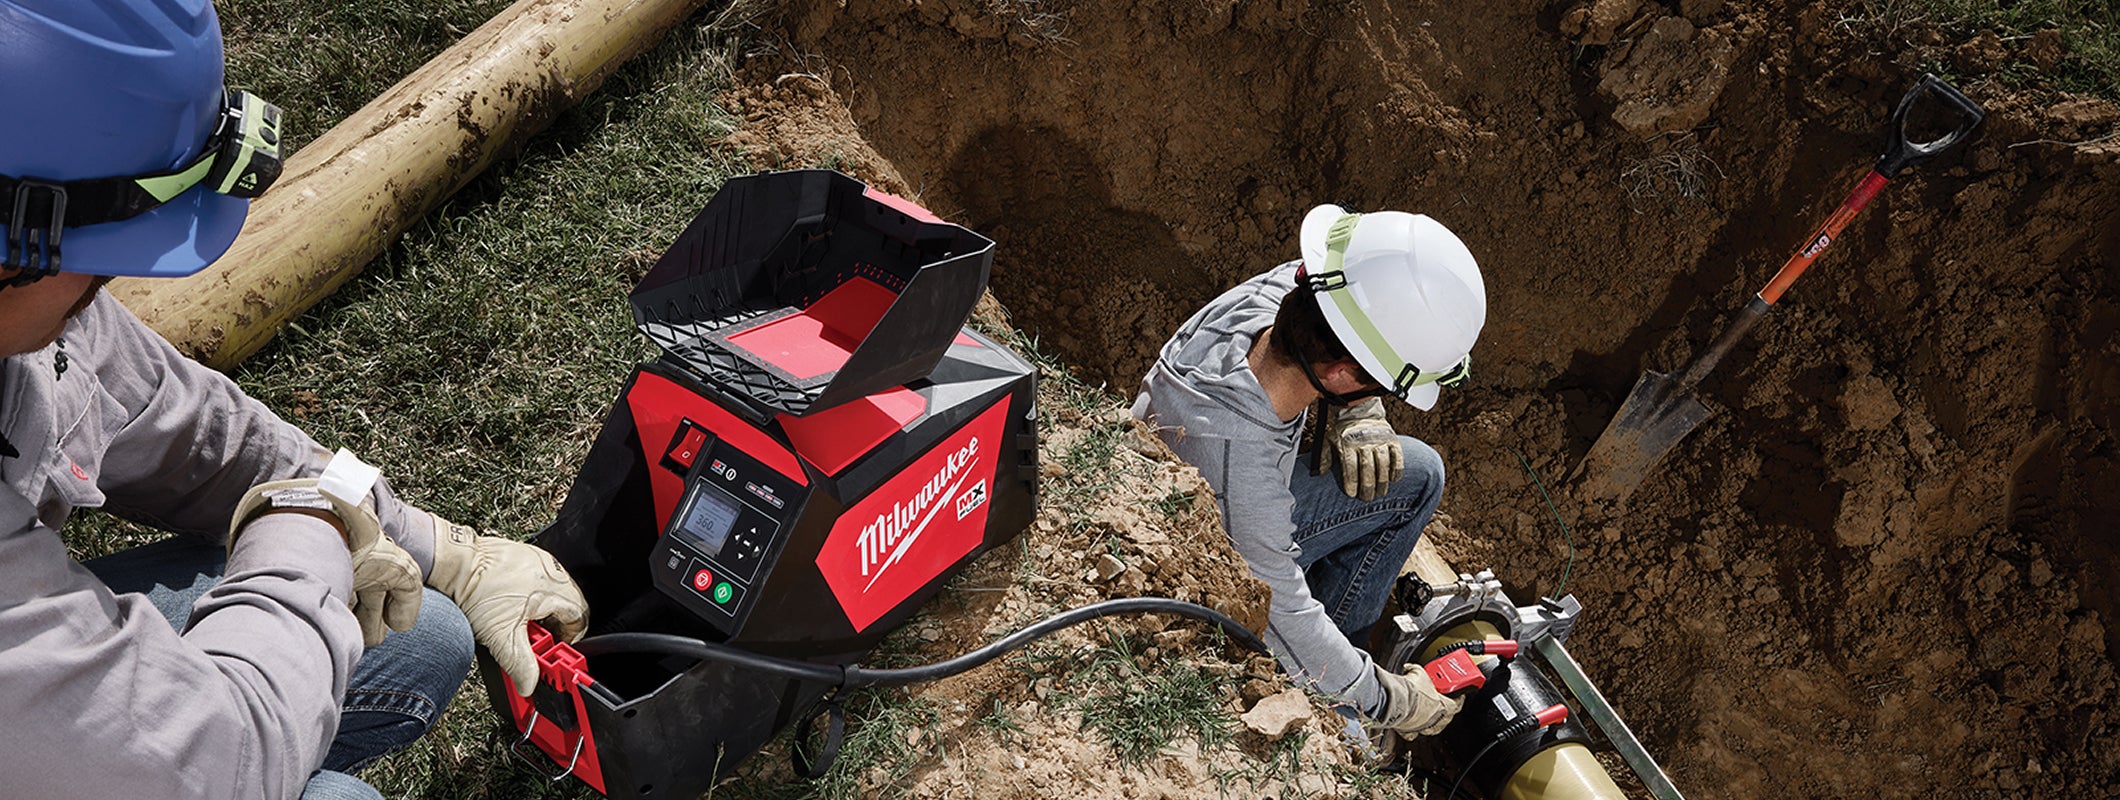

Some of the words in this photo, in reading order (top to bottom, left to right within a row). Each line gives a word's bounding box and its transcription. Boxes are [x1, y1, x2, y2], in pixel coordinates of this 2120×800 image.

[856, 436, 979, 576] Milwaukee
[959, 482, 984, 511] MX
[450, 525, 463, 543] FR
